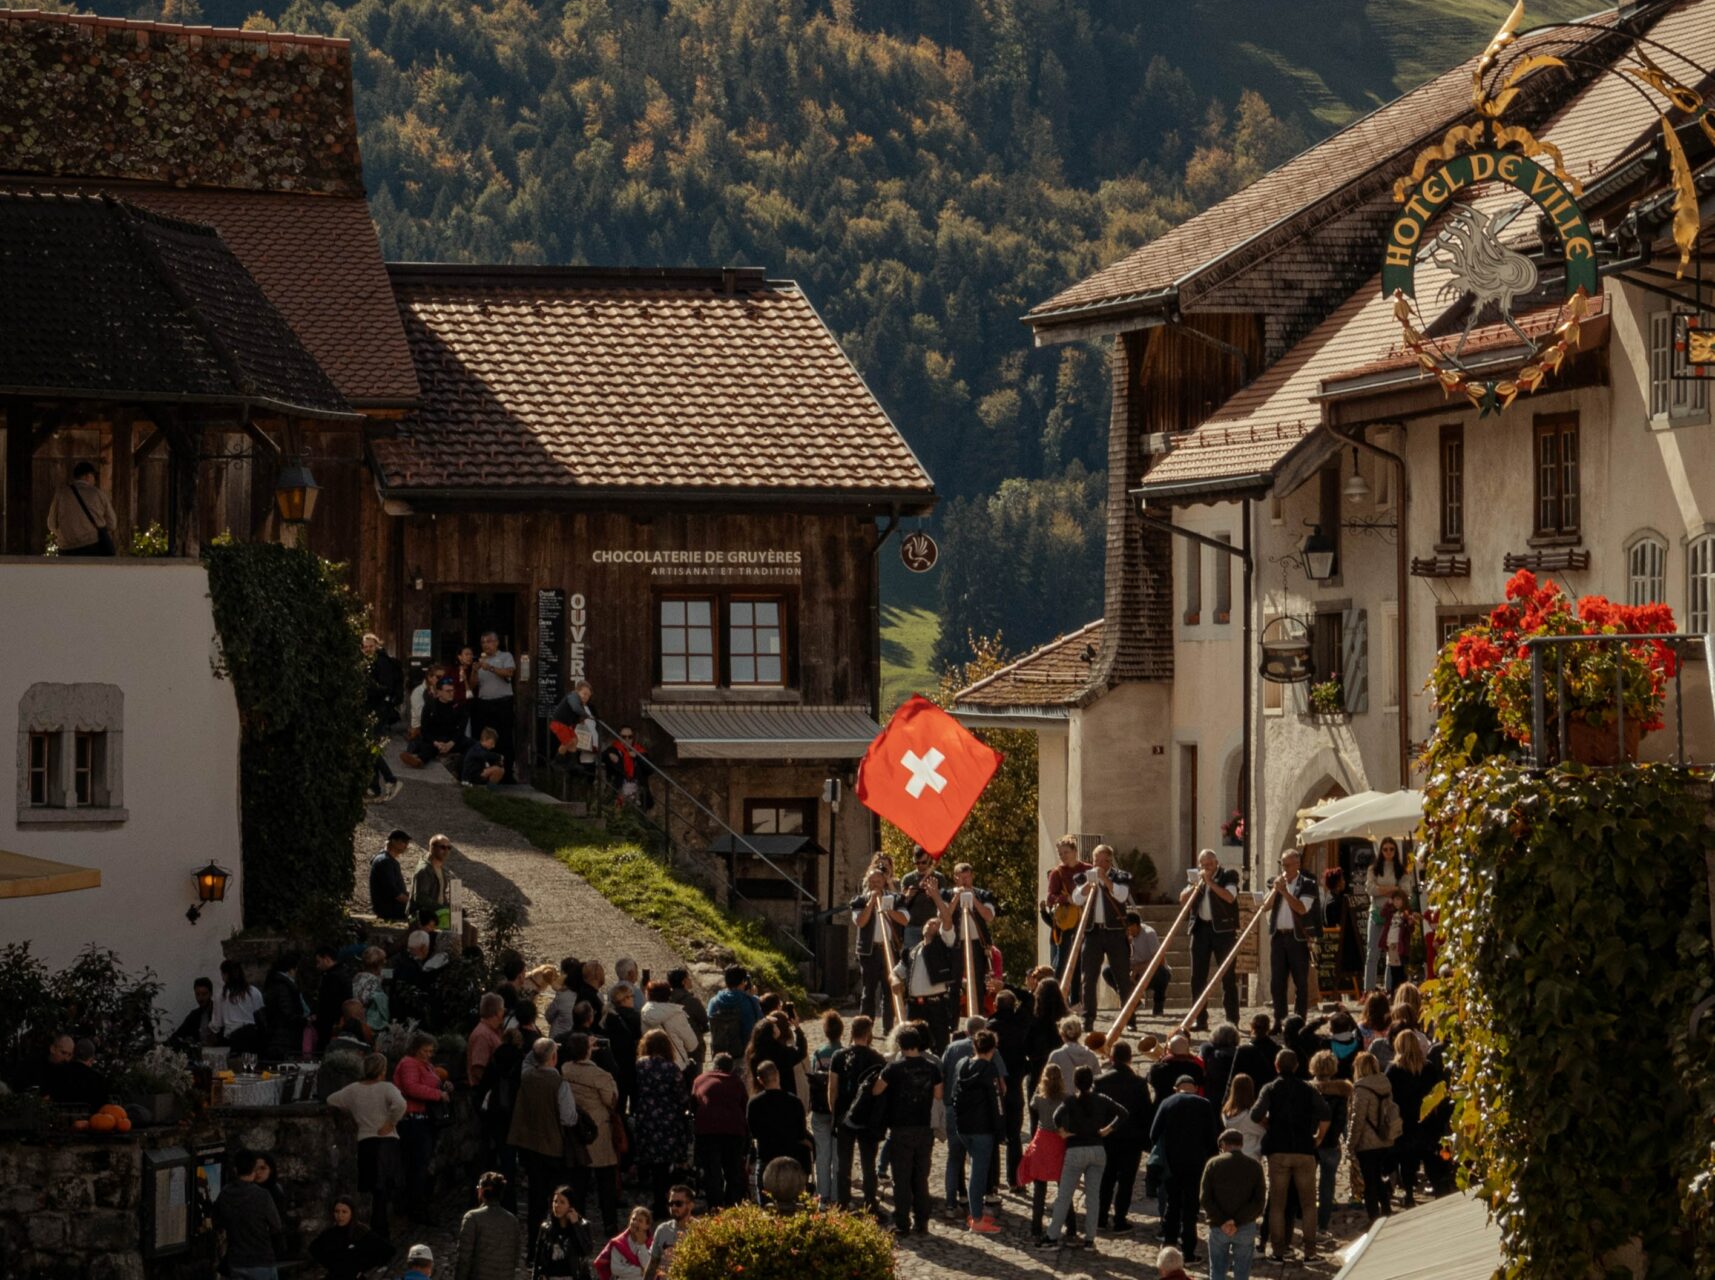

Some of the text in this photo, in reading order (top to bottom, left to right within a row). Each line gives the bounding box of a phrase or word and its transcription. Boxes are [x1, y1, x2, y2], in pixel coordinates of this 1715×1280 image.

[1385, 153, 1595, 267] HOTEL DE VILLE
[592, 548, 802, 564] CHOCOLATERIE DE GRUYÈRES
[651, 567, 802, 576] ARTISANAT ET TRADITION
[570, 593, 587, 690] OUVERT
